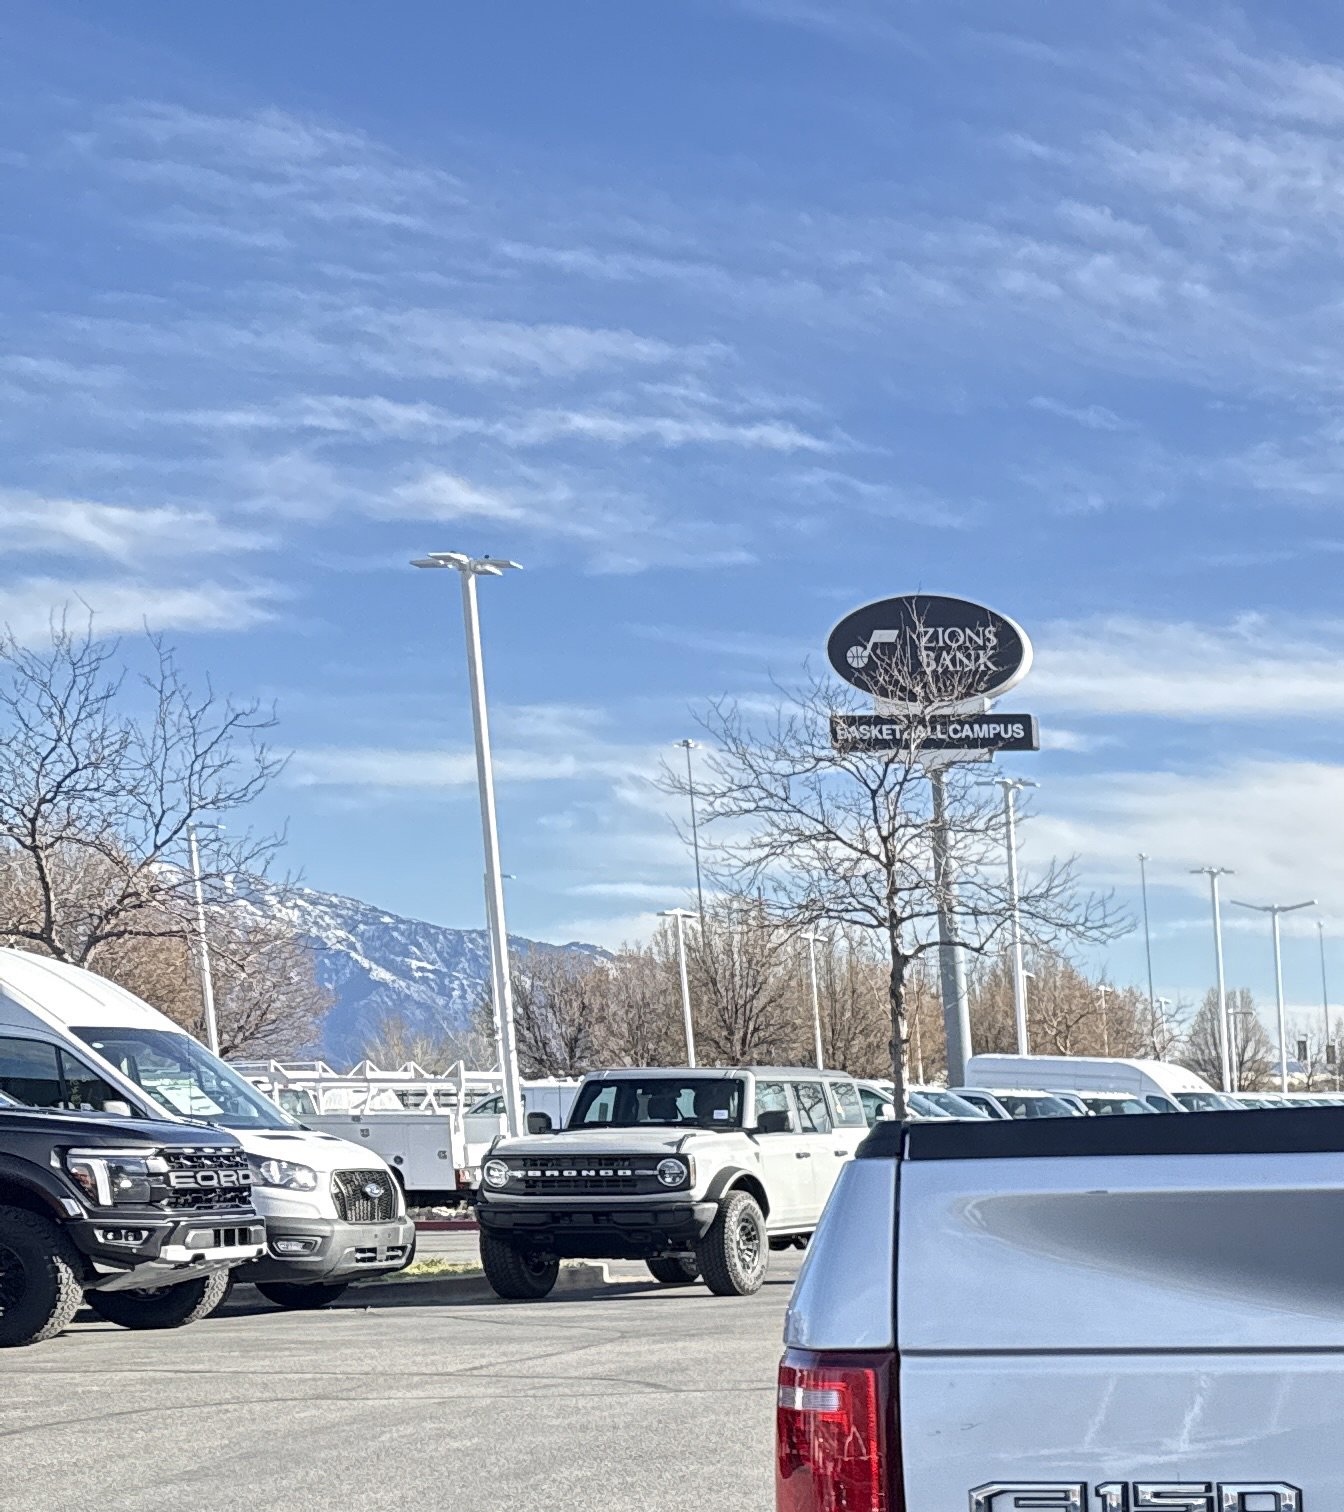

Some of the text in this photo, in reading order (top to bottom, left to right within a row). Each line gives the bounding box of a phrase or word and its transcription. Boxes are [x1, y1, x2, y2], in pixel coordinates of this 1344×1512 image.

[921, 627, 998, 647] ZIONS
[923, 649, 998, 671] BANK
[836, 722, 1026, 740] BASKETALL CAMPUS
